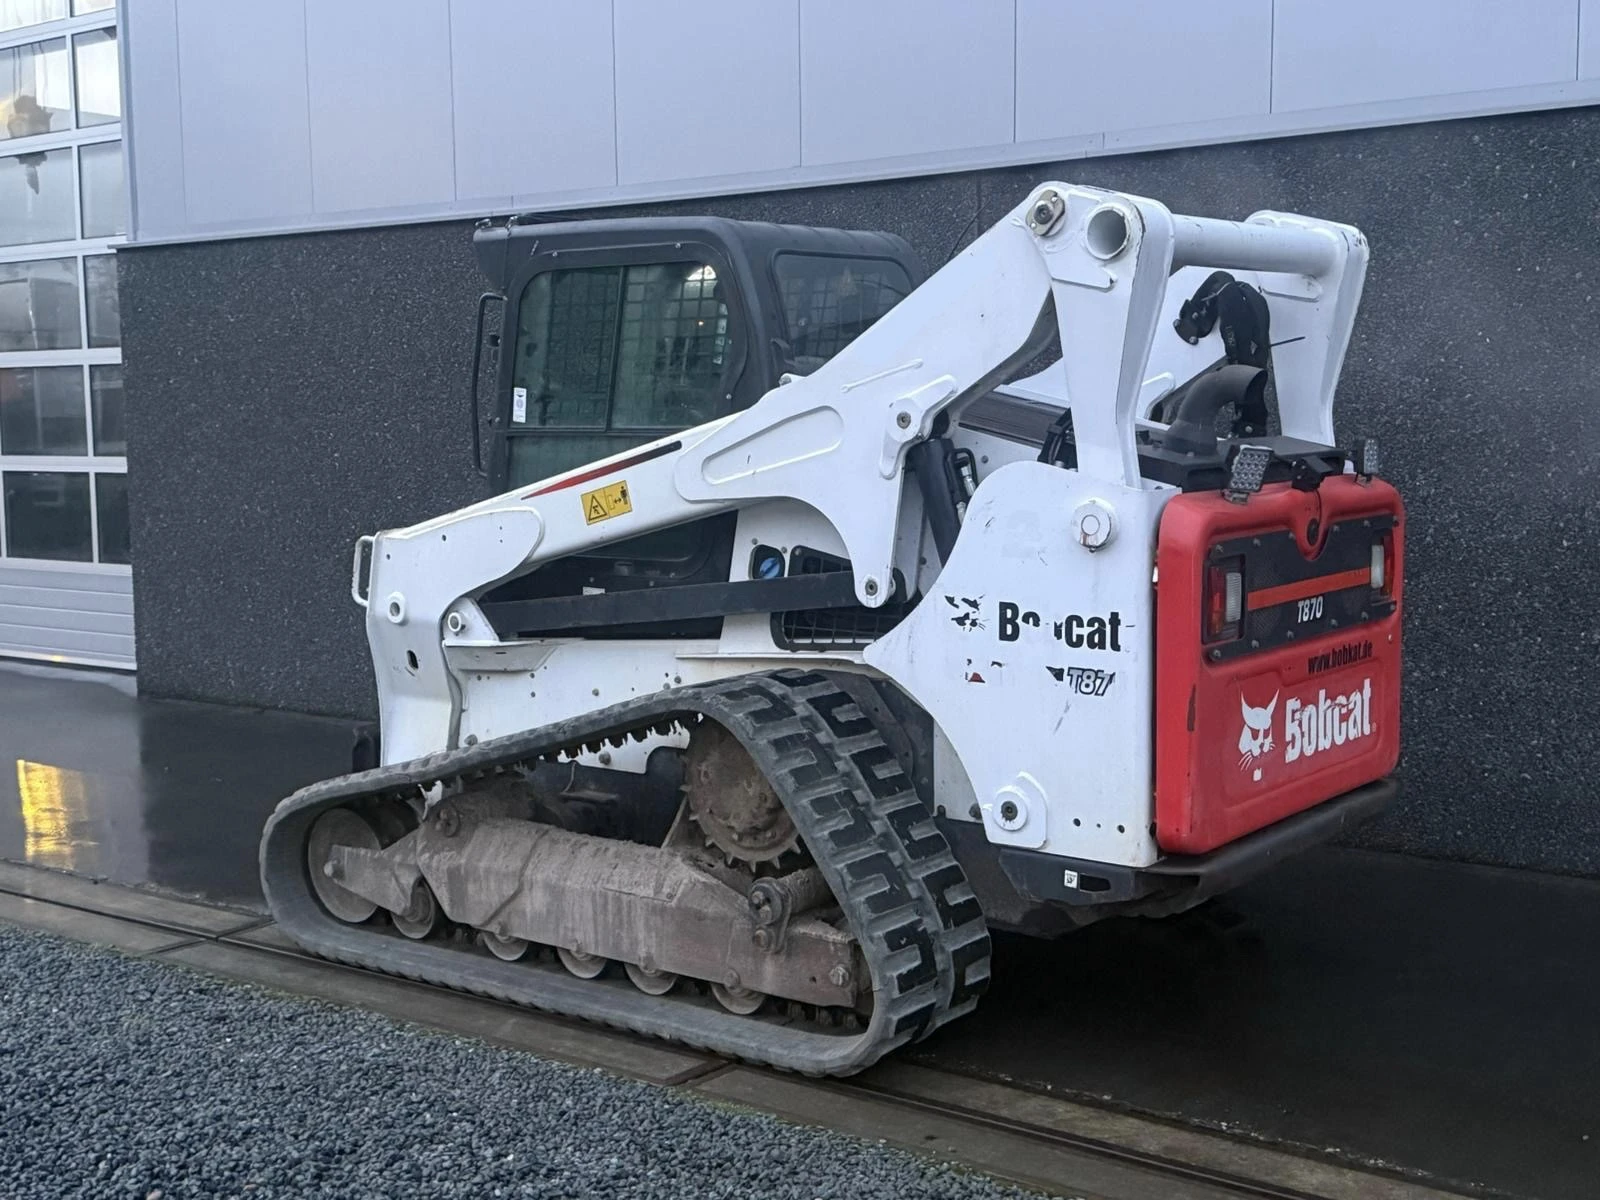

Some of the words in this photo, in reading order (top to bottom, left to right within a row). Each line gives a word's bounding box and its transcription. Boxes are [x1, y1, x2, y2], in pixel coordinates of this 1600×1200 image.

[999, 601, 1121, 652] Bocat
[1298, 596, 1323, 623] T870
[1308, 640, 1372, 674] www.bobkat.de
